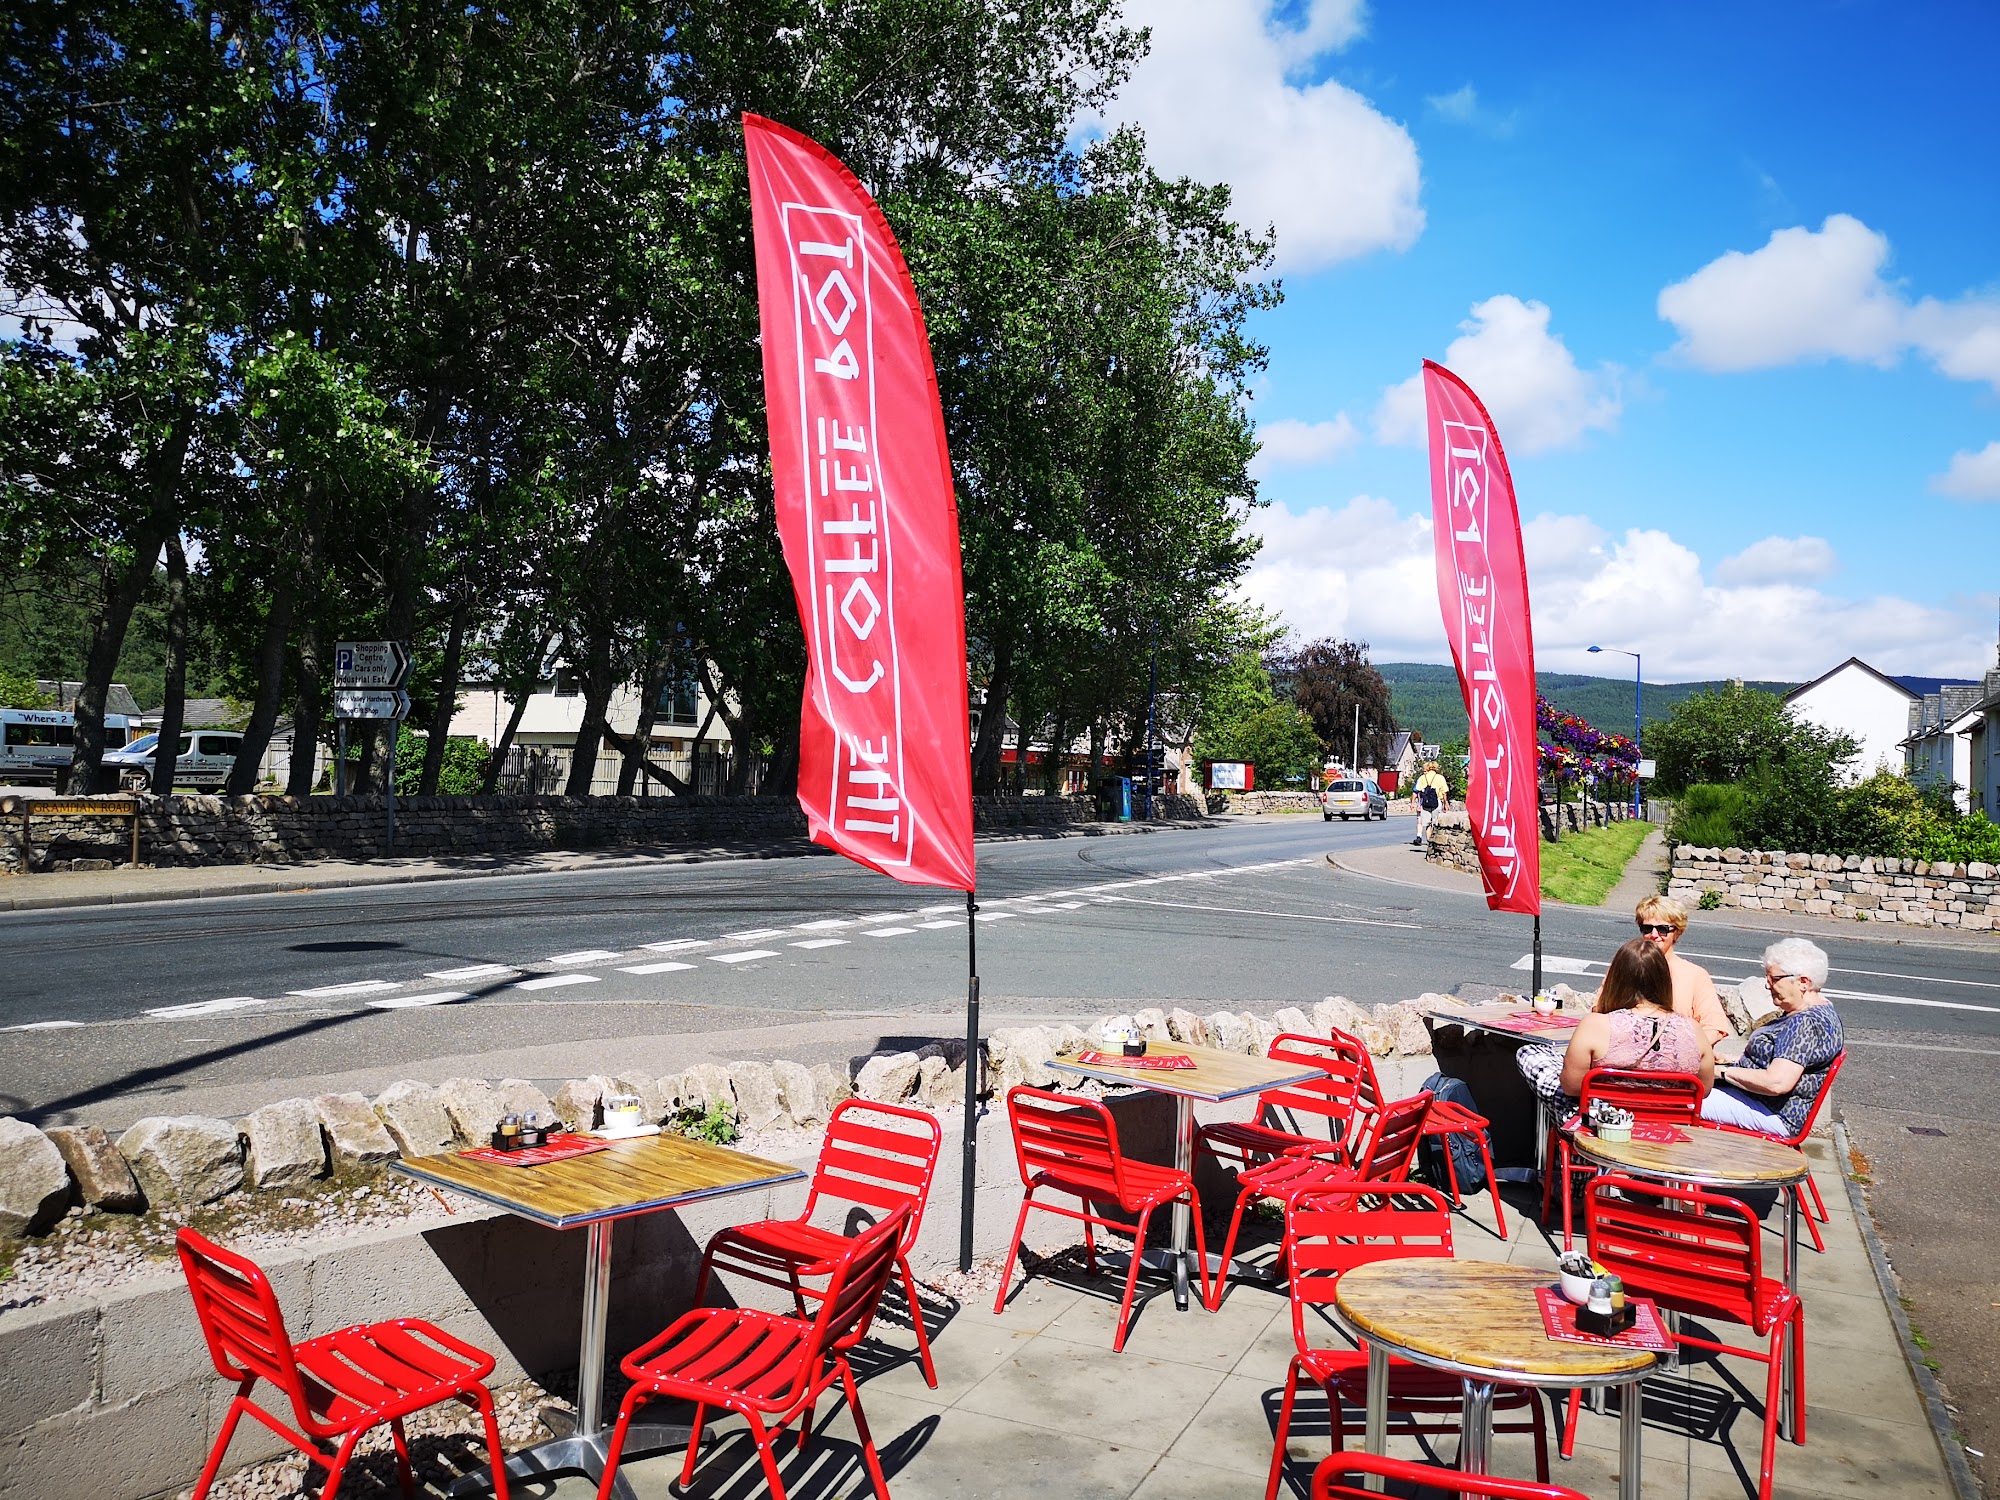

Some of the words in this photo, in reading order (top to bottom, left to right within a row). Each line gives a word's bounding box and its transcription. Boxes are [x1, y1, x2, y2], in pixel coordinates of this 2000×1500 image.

[355, 644, 389, 654] Shopping
[372, 665, 388, 673] only
[61, 715, 68, 724] 2
[34, 802, 96, 813] GRAMPIAN
[101, 802, 131, 813] ROAD
